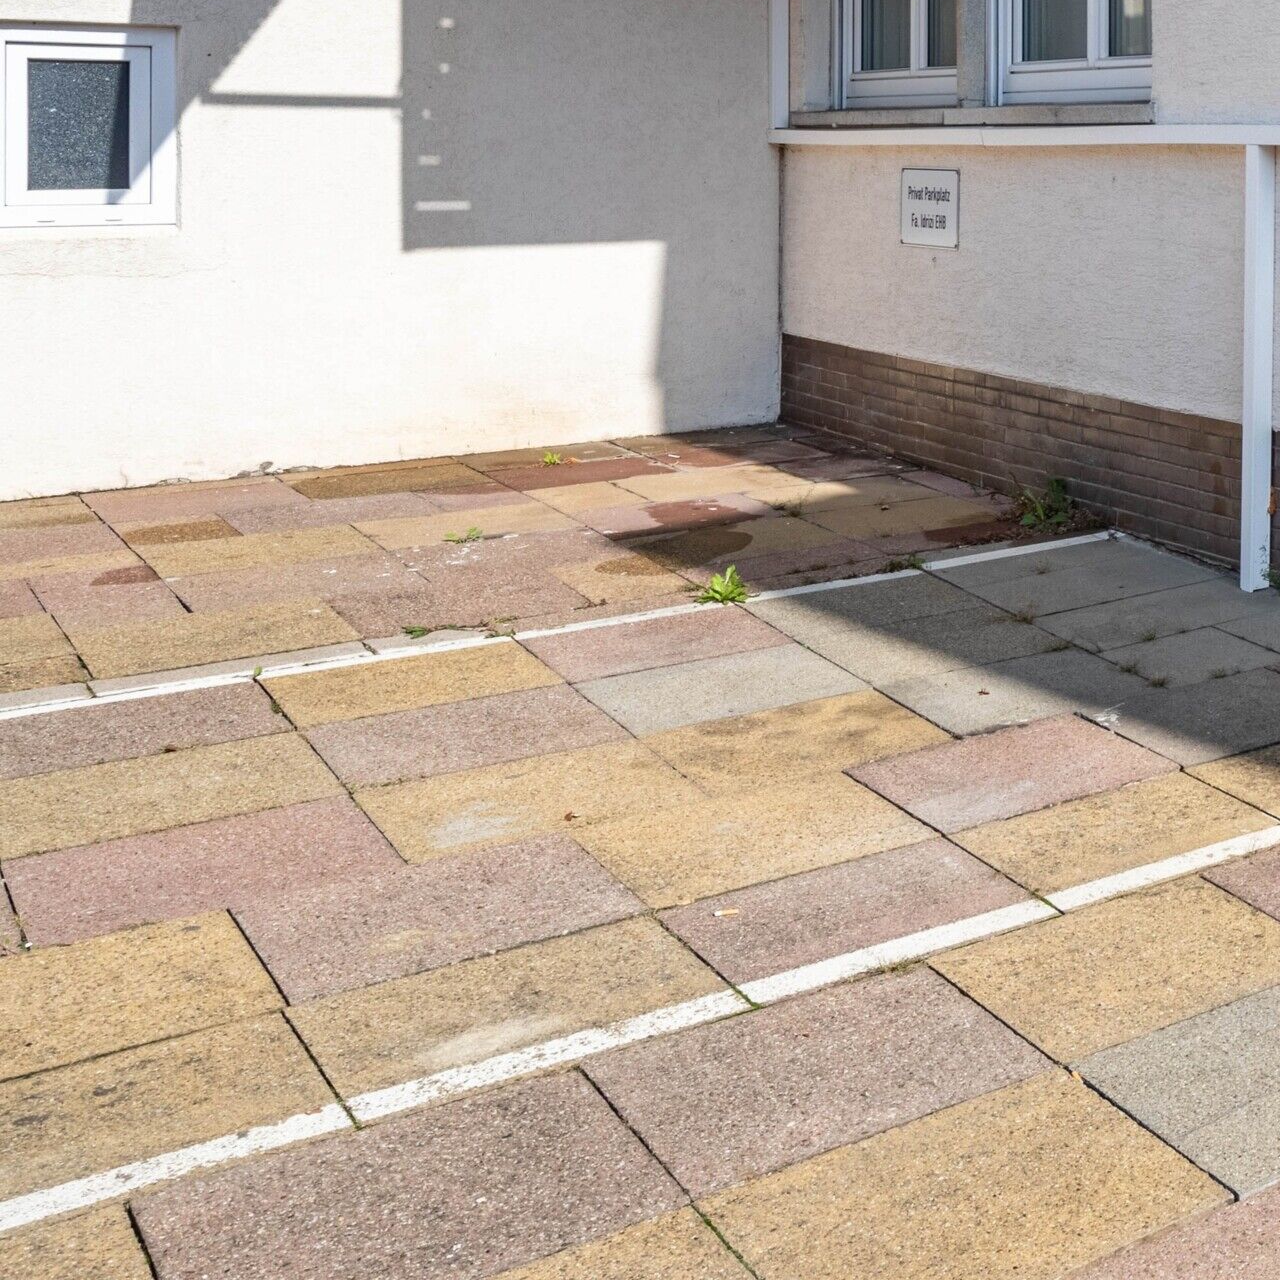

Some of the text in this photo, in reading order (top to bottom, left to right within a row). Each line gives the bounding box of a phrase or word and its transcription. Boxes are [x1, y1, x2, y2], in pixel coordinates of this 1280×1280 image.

[908, 186, 950, 205] Privat Parkplatz
[935, 214, 946, 229] EHB
